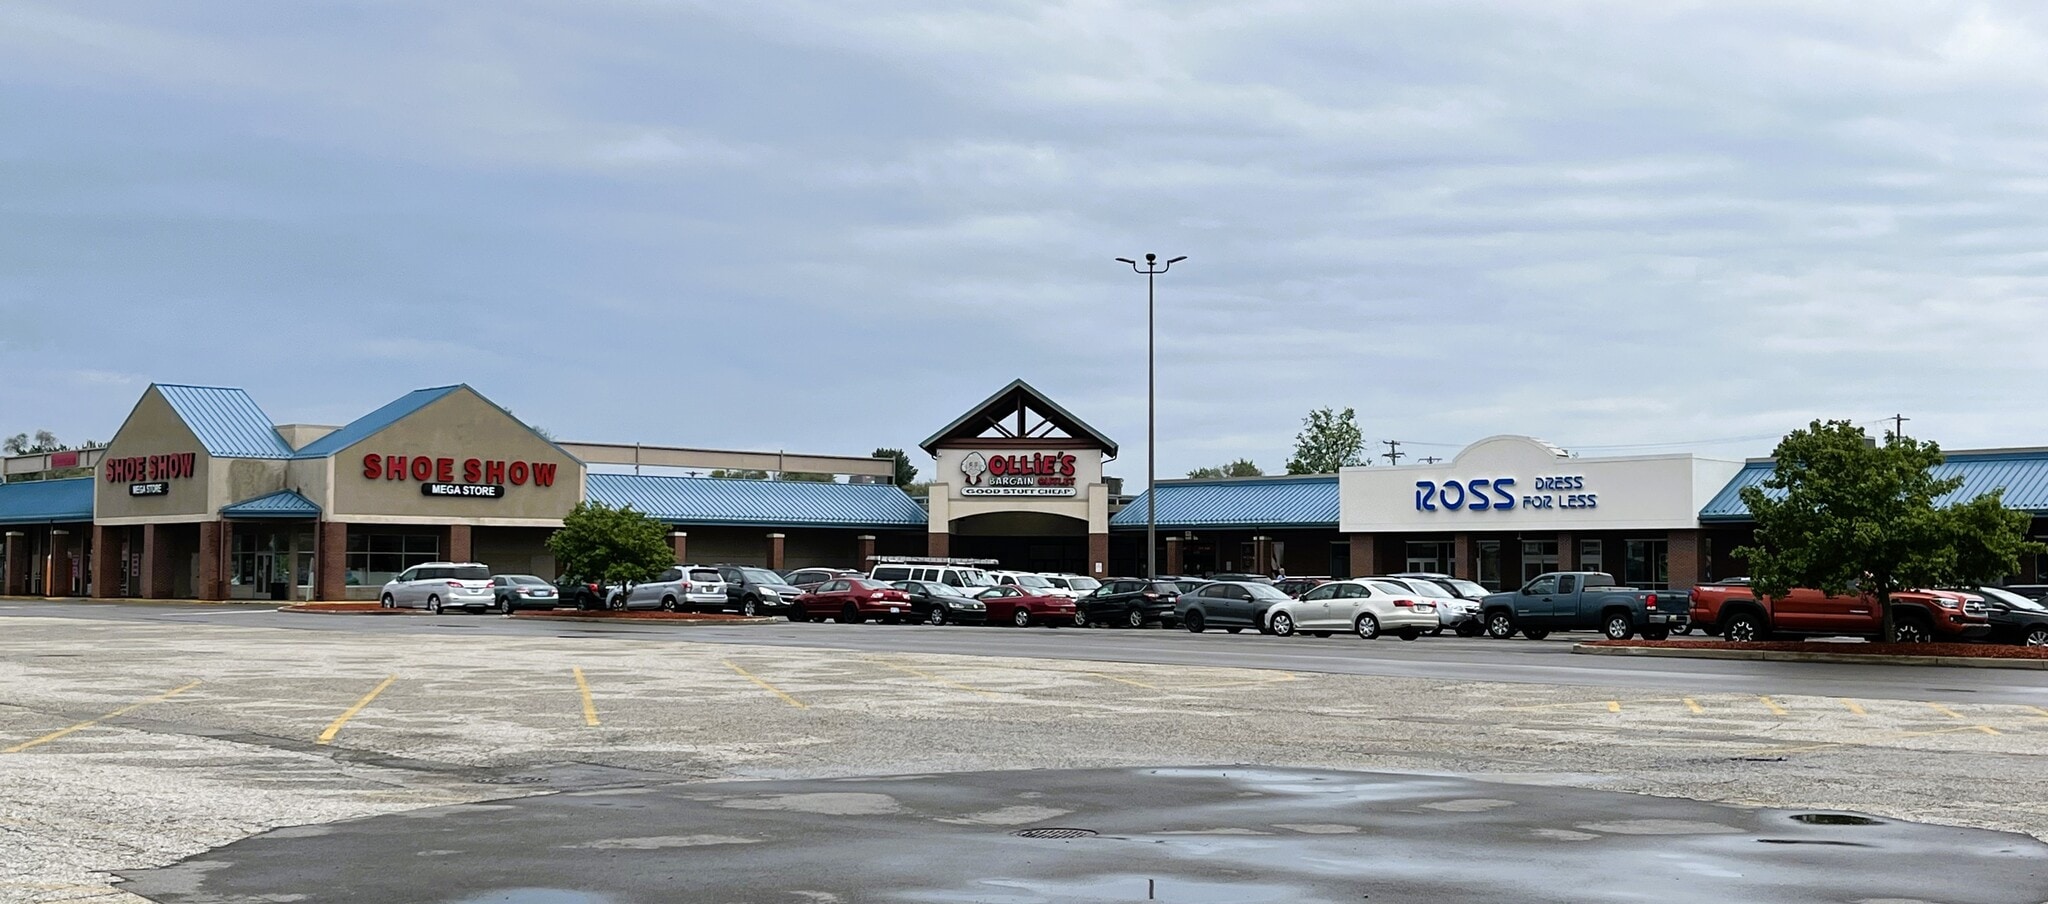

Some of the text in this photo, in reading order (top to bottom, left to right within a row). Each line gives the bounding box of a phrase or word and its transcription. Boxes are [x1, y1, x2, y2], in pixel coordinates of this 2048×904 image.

[105, 452, 196, 483] SHOE SHOW
[363, 453, 557, 487] SHOE SHOW
[132, 483, 162, 494] MEGA STORE
[989, 477, 1034, 486] BARGAIN
[1535, 476, 1583, 490] DRESS
[431, 484, 496, 496] MEGA STORE
[1415, 478, 1515, 511] ROSS
[1522, 494, 1598, 508] FOR LESS
